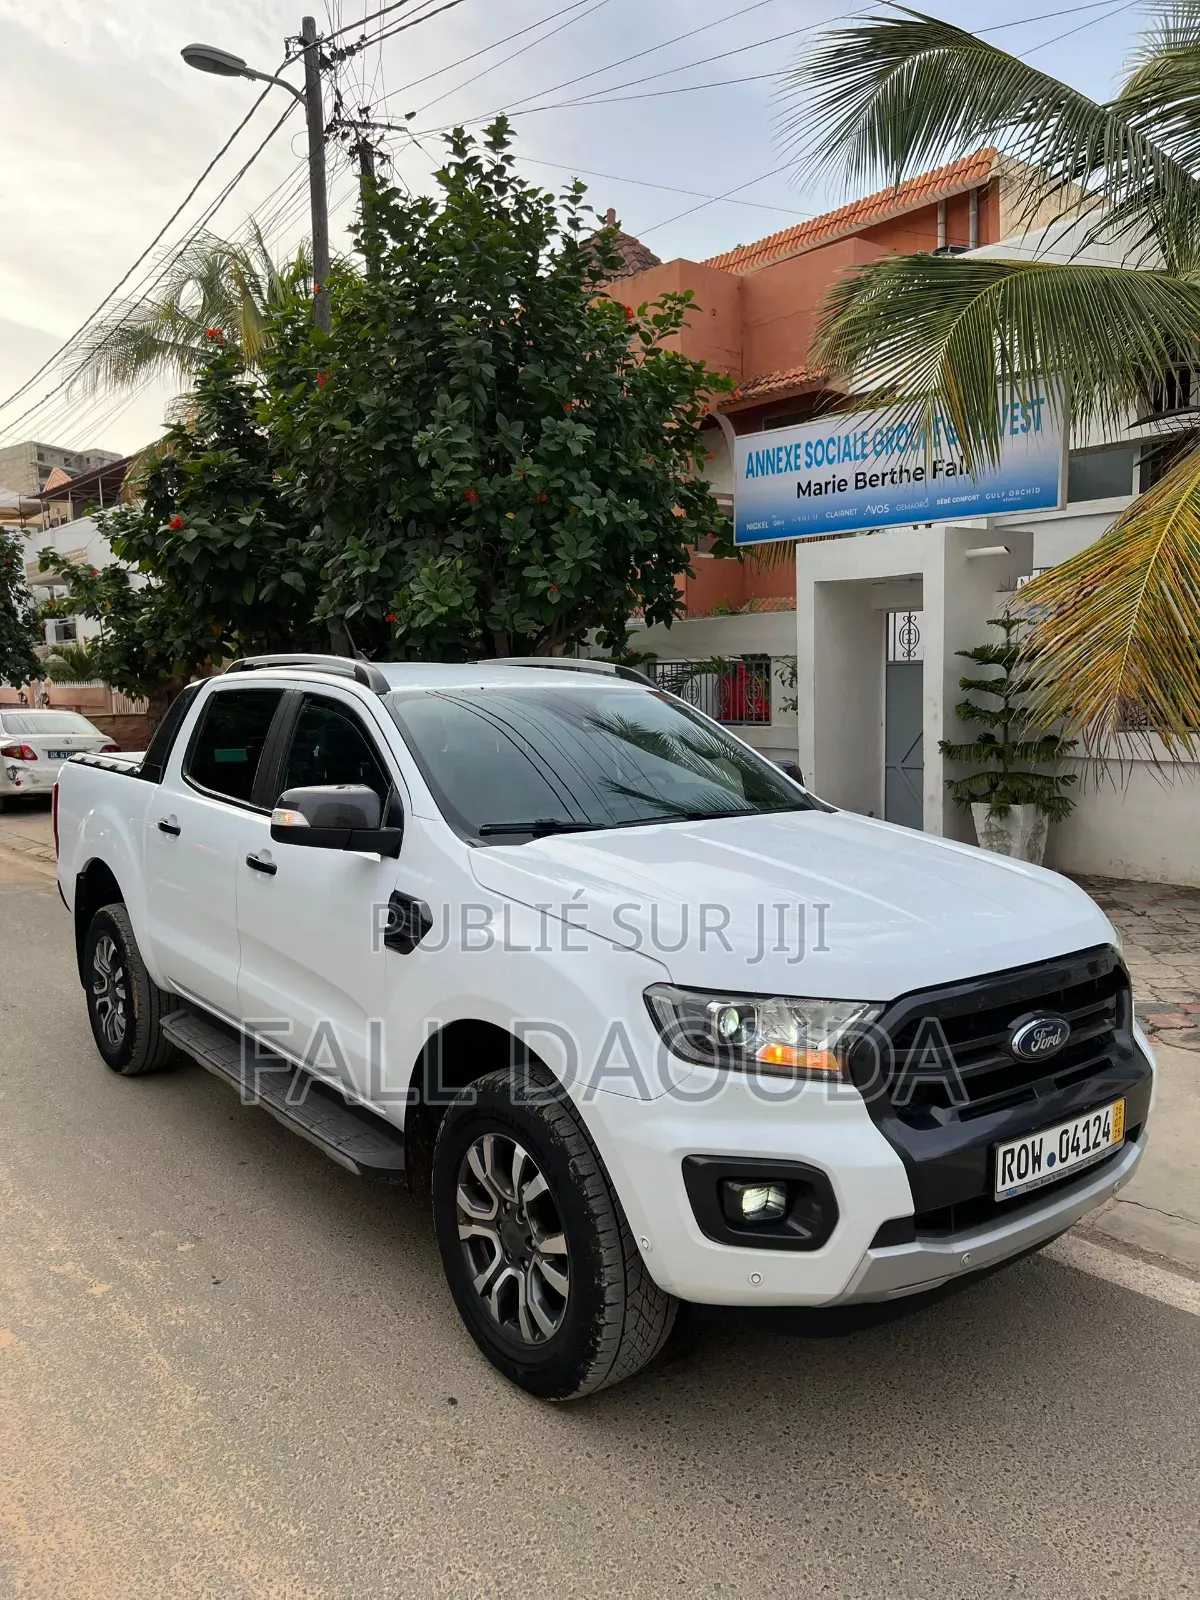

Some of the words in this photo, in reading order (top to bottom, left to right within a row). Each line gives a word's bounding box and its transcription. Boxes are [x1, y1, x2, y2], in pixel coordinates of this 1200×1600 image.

[745, 443, 801, 479] ANNEXE
[805, 431, 869, 469] SOCIALE
[797, 474, 848, 498] Marie
[855, 465, 925, 490] Berthe
[952, 494, 980, 504] CONFORT
[985, 491, 1005, 500] GULF
[1009, 487, 1041, 497] ORCHID
[825, 508, 858, 519] CLAIRNET
[746, 521, 769, 531] NICKEL
[1031, 1025, 1061, 1052] Ford
[1001, 1137, 1043, 1186] ROW
[1058, 1110, 1111, 1164] 04124
